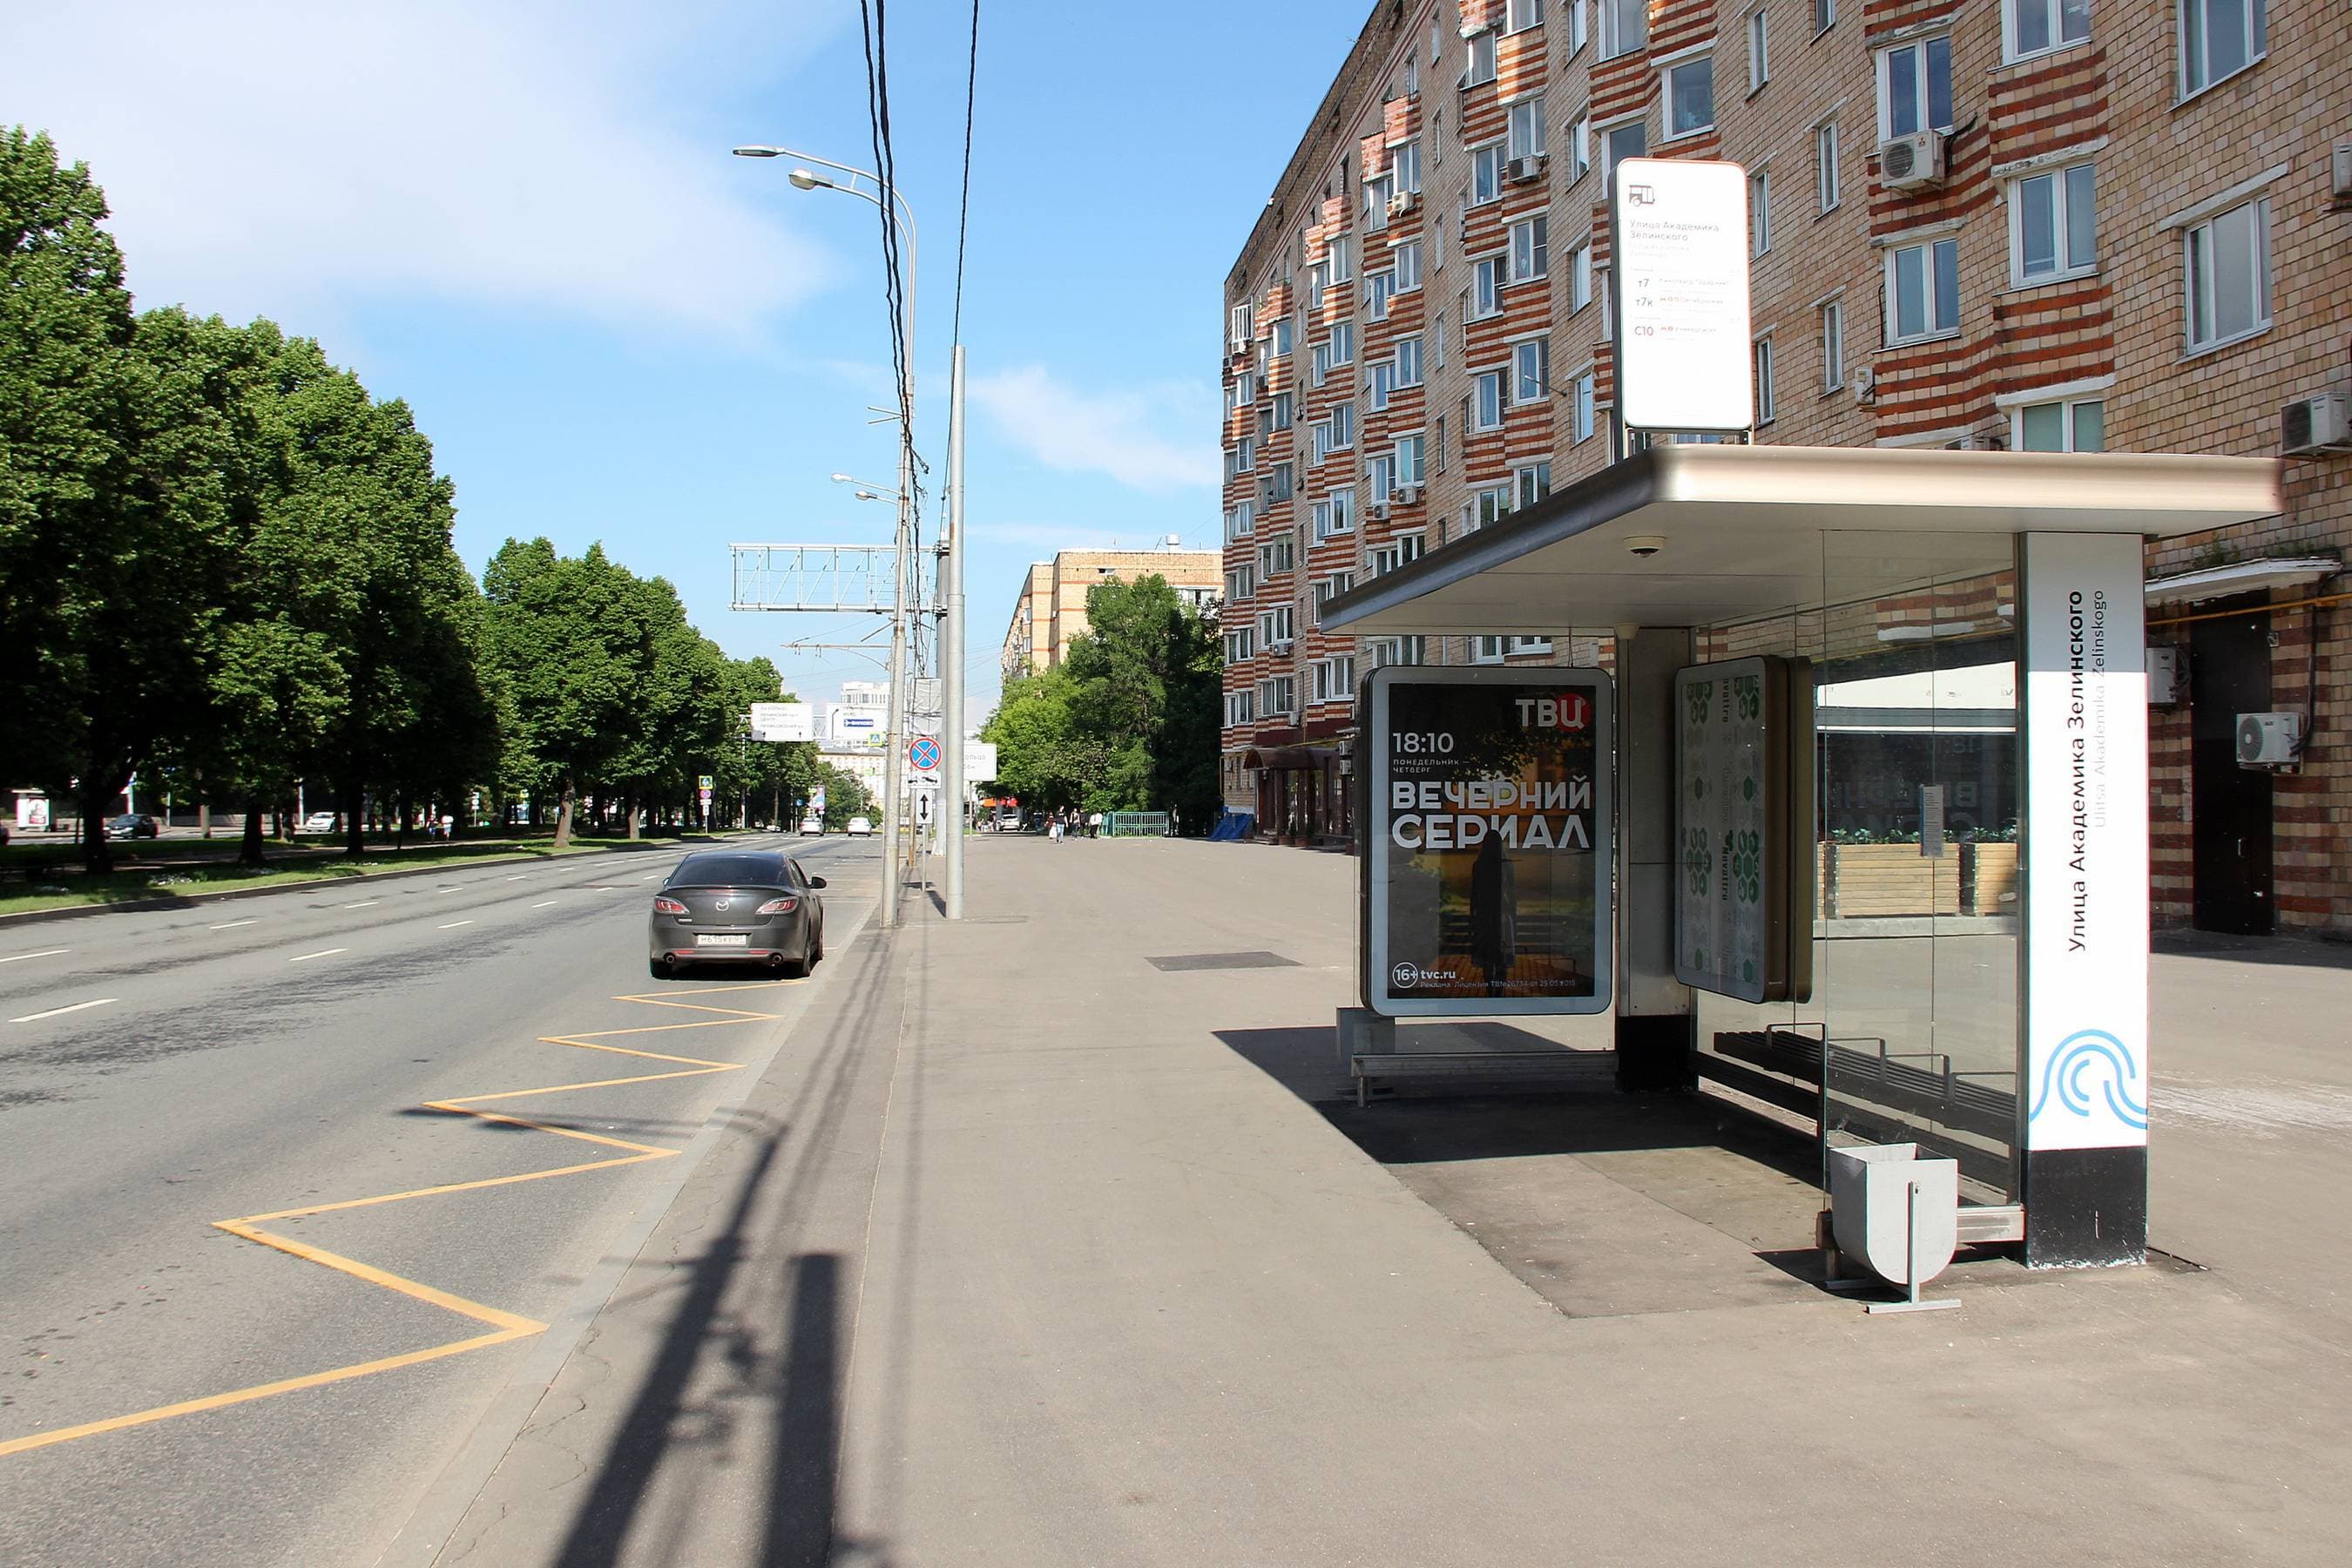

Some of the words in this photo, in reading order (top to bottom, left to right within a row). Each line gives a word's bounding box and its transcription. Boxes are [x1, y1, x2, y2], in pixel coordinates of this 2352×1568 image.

[1629, 219, 1660, 229] Улица
[1662, 220, 1720, 232] Академика
[1630, 230, 1688, 241] Зелинского
[2091, 590, 2107, 677] Zelinskogo
[2067, 591, 2085, 730] Зелинского
[1515, 698, 1585, 730] ТВЦ
[2092, 686, 2106, 776] Akademika
[1393, 733, 1454, 754] 18:10
[1392, 774, 1591, 809] ВЕЧЕРНИЙ
[2067, 738, 2087, 872] Академика
[2092, 784, 2106, 828] Ulitsa
[1392, 814, 1590, 849] СЕРИАЛ
[2067, 880, 2087, 952] Улица
[1396, 969, 1418, 981] 16+
[1420, 969, 1456, 979] tvc.ru
